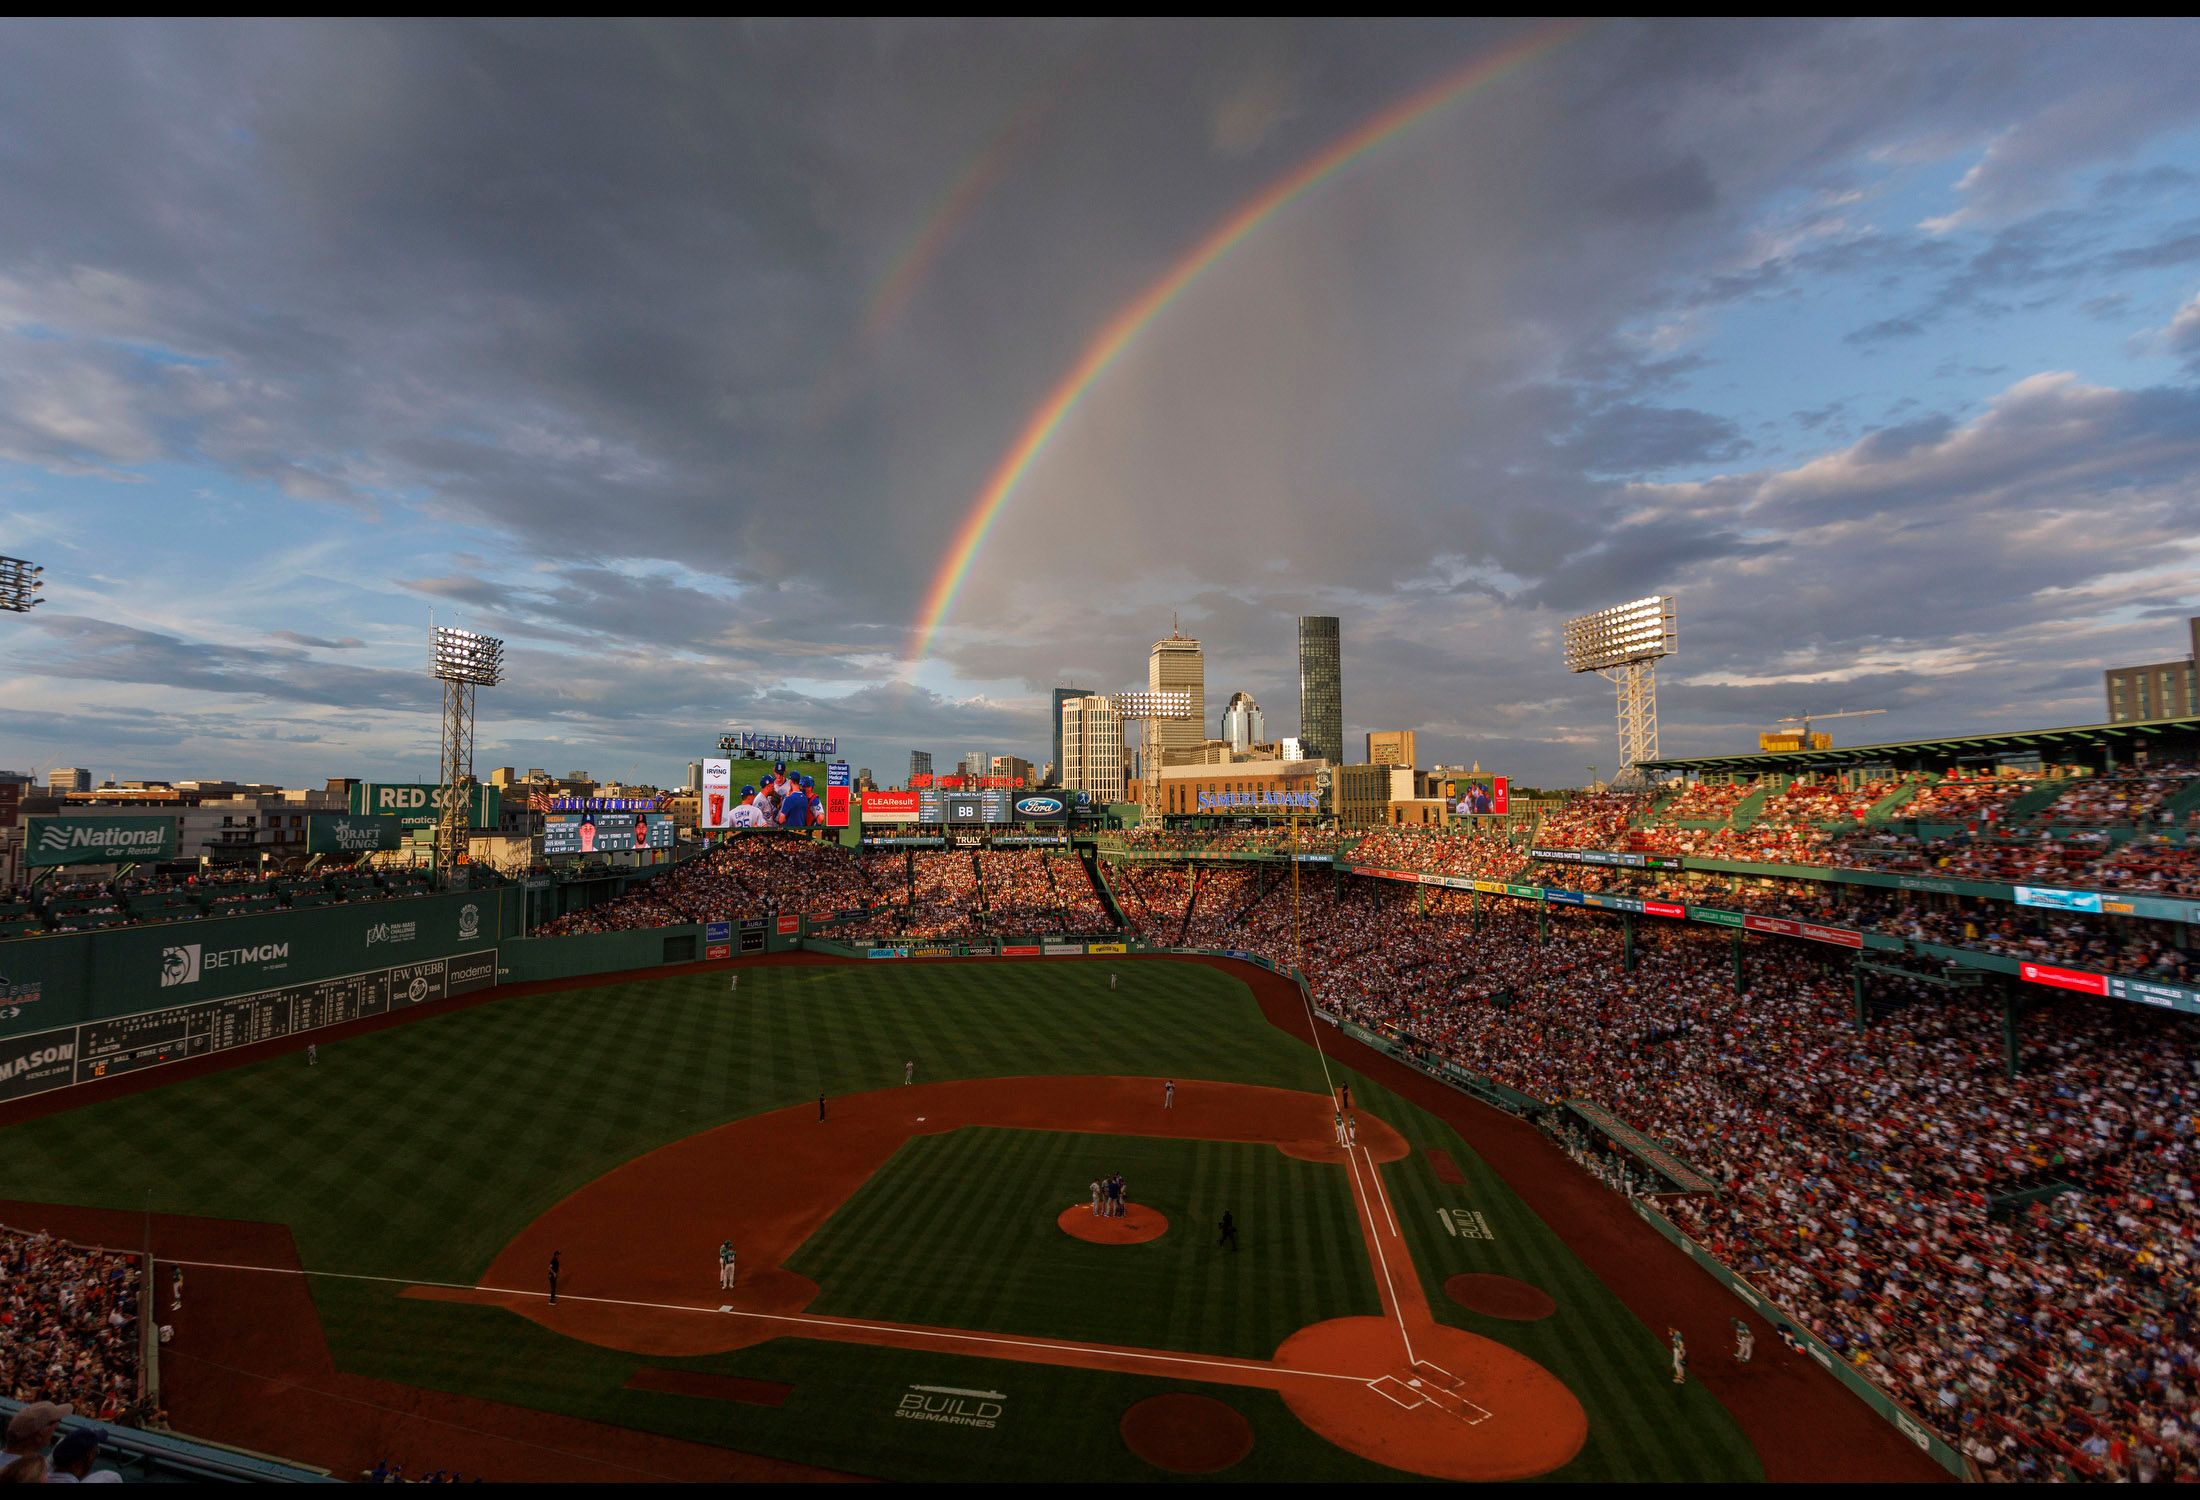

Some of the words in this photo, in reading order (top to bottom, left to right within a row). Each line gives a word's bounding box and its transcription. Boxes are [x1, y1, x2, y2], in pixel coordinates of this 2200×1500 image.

[741, 732, 837, 754] MassMutual
[936, 777, 966, 787] new
[966, 774, 1025, 787] balance
[380, 788, 426, 808] RED
[605, 797, 654, 811] AMERICA
[1198, 791, 1260, 809] SAMUEL
[1262, 790, 1319, 808] ADAMS
[958, 806, 973, 817] BB
[1025, 799, 1053, 812] Ford
[401, 815, 438, 824] anatics
[71, 826, 165, 847] National
[336, 829, 381, 842] DRAFT
[340, 839, 379, 849] KINGS
[601, 840, 606, 849] 0
[613, 840, 618, 848] 0
[105, 847, 125, 857] Car
[127, 846, 161, 856] Rental
[2104, 902, 2135, 913] STORY
[204, 942, 289, 970] BETMGM
[969, 946, 992, 954] wasabi
[414, 962, 444, 977] WEBB
[450, 964, 492, 981] moderna
[223, 996, 257, 1006] AMERICAN
[257, 991, 282, 1000] LEAGUE
[393, 991, 408, 1000] Since
[2143, 995, 2173, 1007] BOSTON
[107, 1015, 154, 1029] FENWAY
[161, 1009, 189, 1019] PARK
[0, 1043, 75, 1082] MASON
[899, 1393, 1003, 1419] BUILD
[894, 1409, 997, 1429] SUBMARINES
